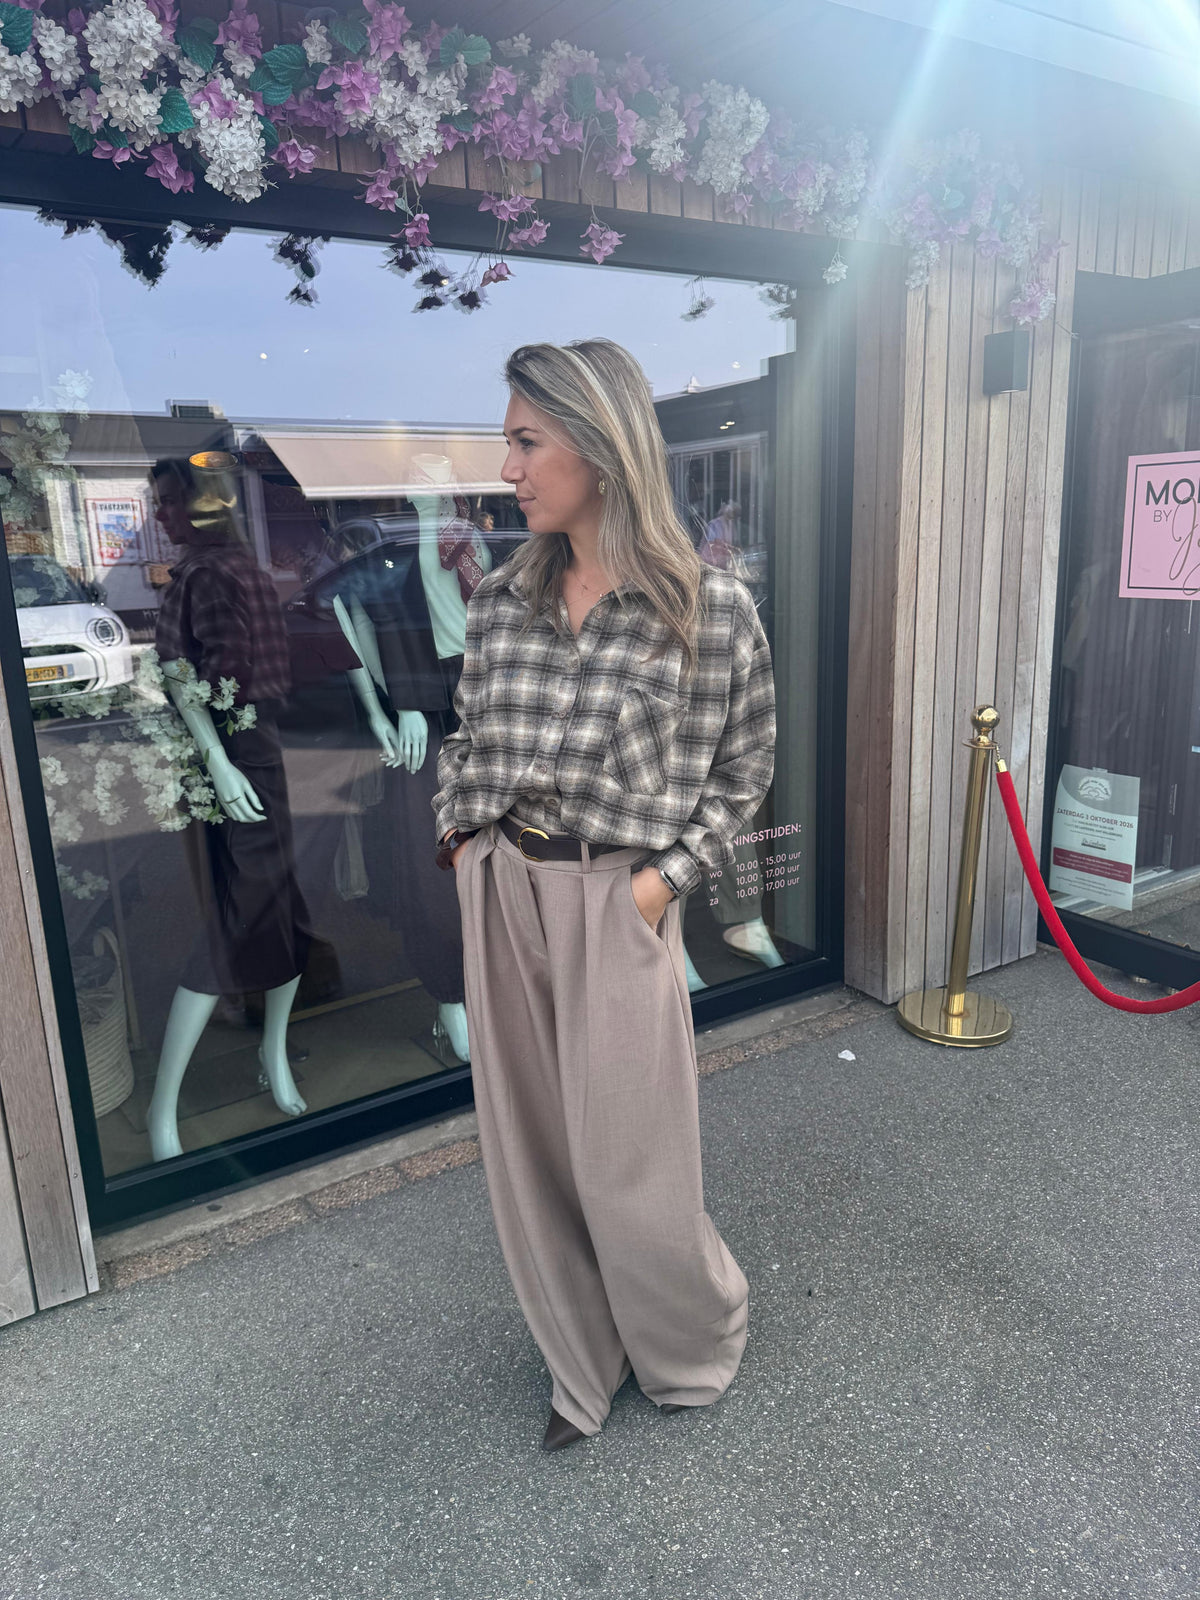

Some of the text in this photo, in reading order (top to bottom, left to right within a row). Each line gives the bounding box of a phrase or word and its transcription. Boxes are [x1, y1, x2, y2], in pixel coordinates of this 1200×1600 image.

[1145, 478, 1200, 506] MO
[1153, 497, 1200, 581] BY J
[1056, 807, 1084, 819] ZATERDAG
[1090, 815, 1118, 826] OKTOBER
[709, 870, 723, 879] wo
[736, 860, 758, 873] 10.00
[765, 853, 787, 866] 15.00
[788, 851, 802, 861] uur
[709, 884, 719, 892] vr
[736, 873, 758, 886] 10.00
[765, 866, 786, 879] 17.00
[787, 864, 800, 874] uur
[709, 898, 719, 907] za
[736, 886, 758, 899] 10.00
[765, 879, 786, 892] 17.00
[787, 877, 800, 886] uur
